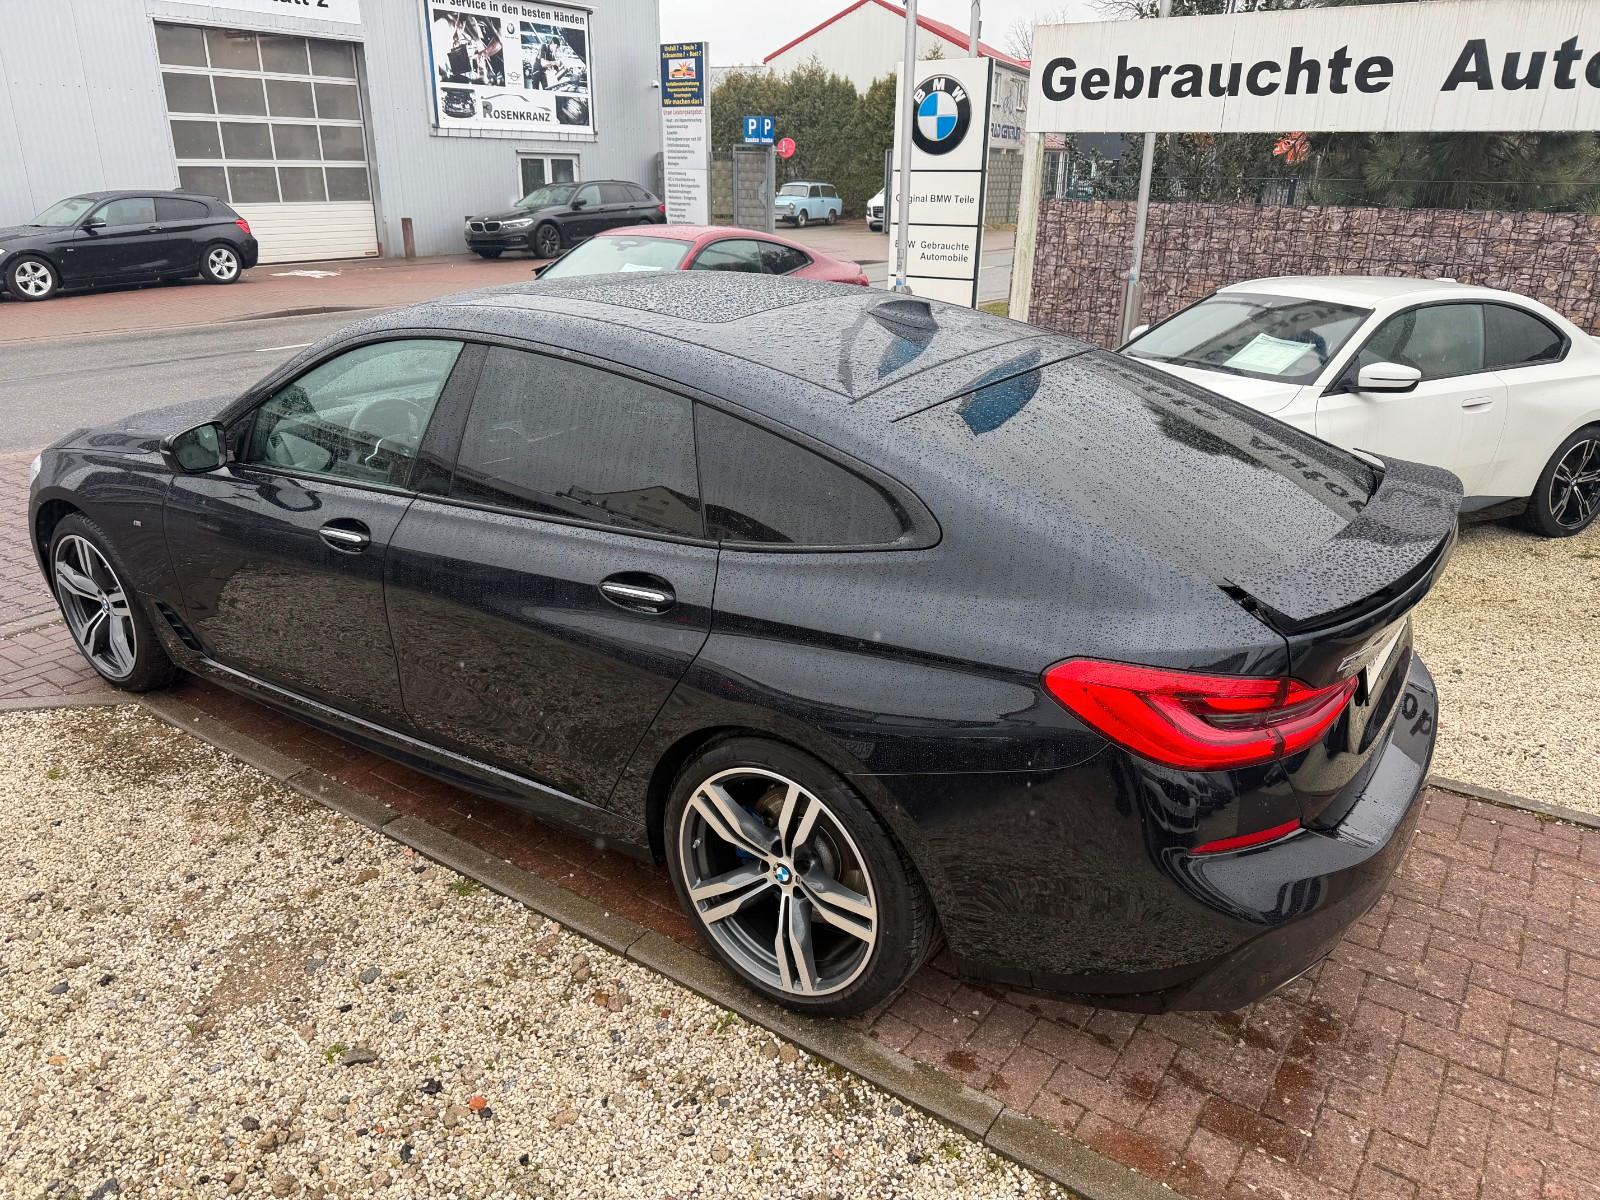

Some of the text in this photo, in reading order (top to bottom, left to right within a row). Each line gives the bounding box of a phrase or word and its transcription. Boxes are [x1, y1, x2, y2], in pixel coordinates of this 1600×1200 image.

[490, 2, 498, 12] in
[502, 3, 518, 15] den
[521, 6, 551, 20] besten
[554, 11, 585, 25] Händen
[1042, 45, 1394, 101] Gebrauchte
[913, 79, 966, 104] BMW
[482, 100, 550, 122] ROSENKRANZ
[748, 118, 757, 135] P
[764, 118, 771, 135] P
[930, 194, 951, 203] BMW
[954, 195, 975, 204] Teile
[920, 241, 970, 251] Gebrauchte
[919, 252, 969, 263] Automobile
